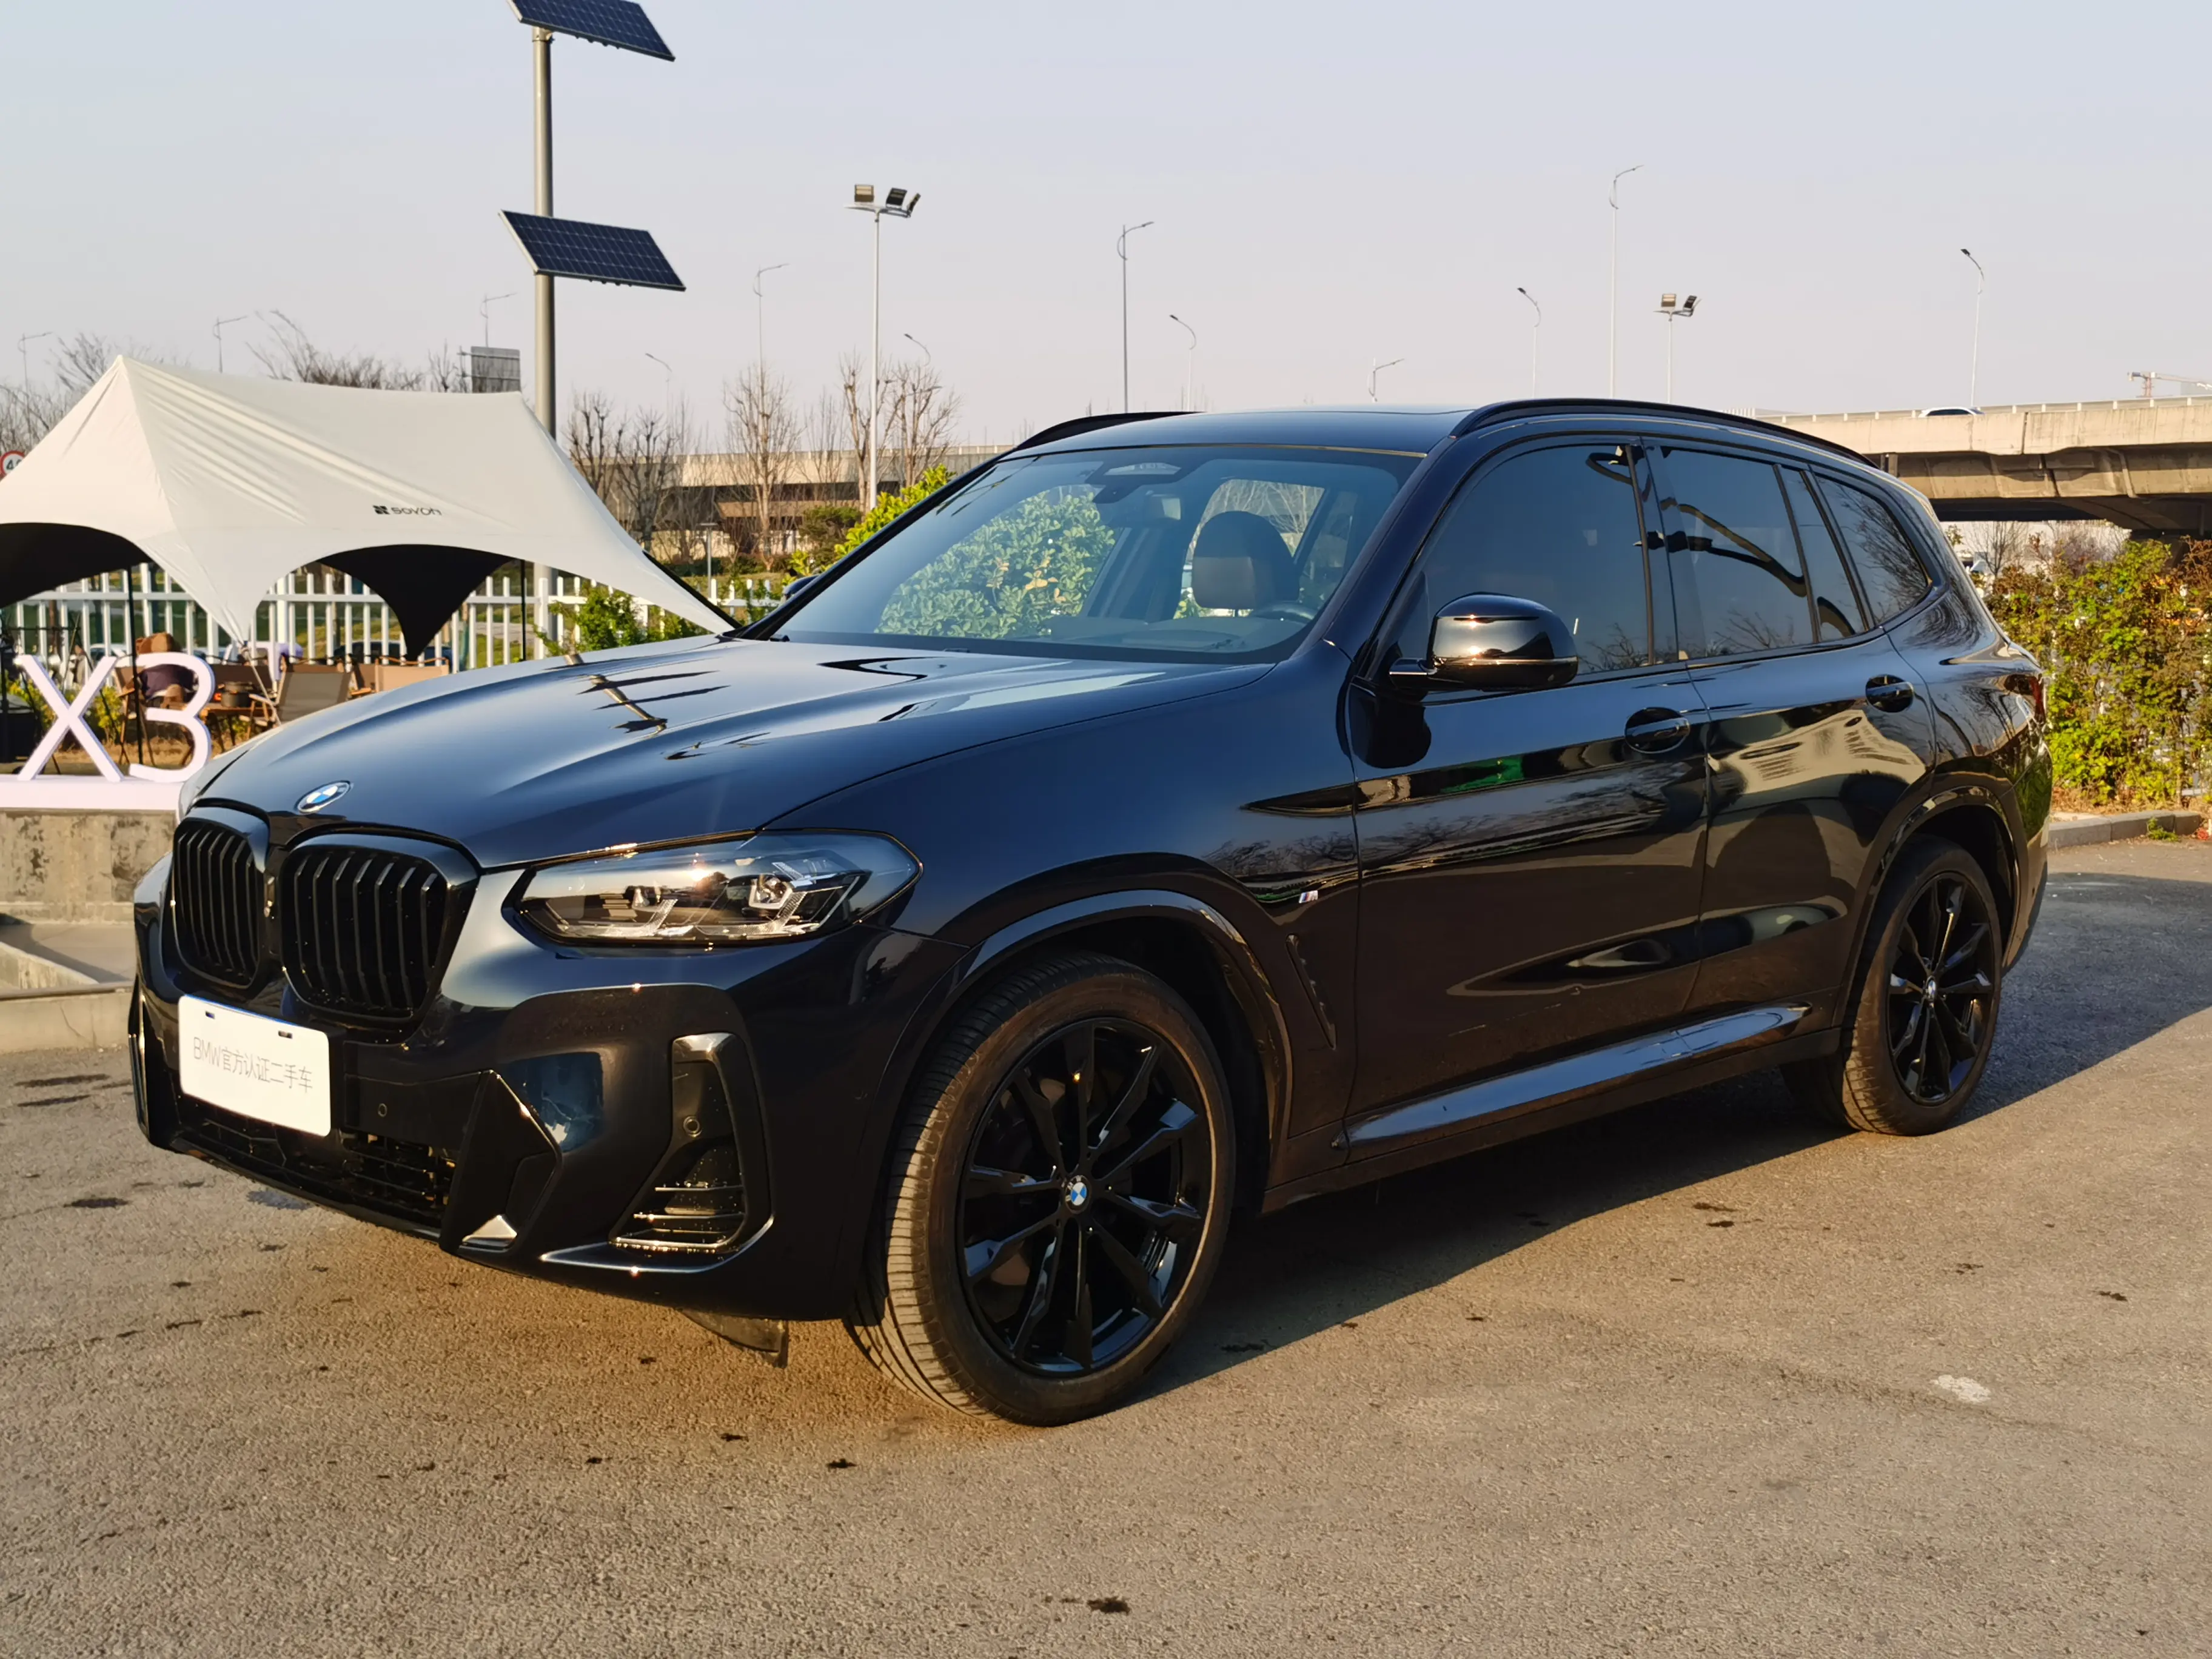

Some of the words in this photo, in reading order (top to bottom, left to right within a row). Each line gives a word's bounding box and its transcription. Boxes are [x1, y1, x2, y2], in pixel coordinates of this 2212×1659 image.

[17, 652, 215, 783] X3
[193, 1036, 313, 1093] BMW官方认证二手车
